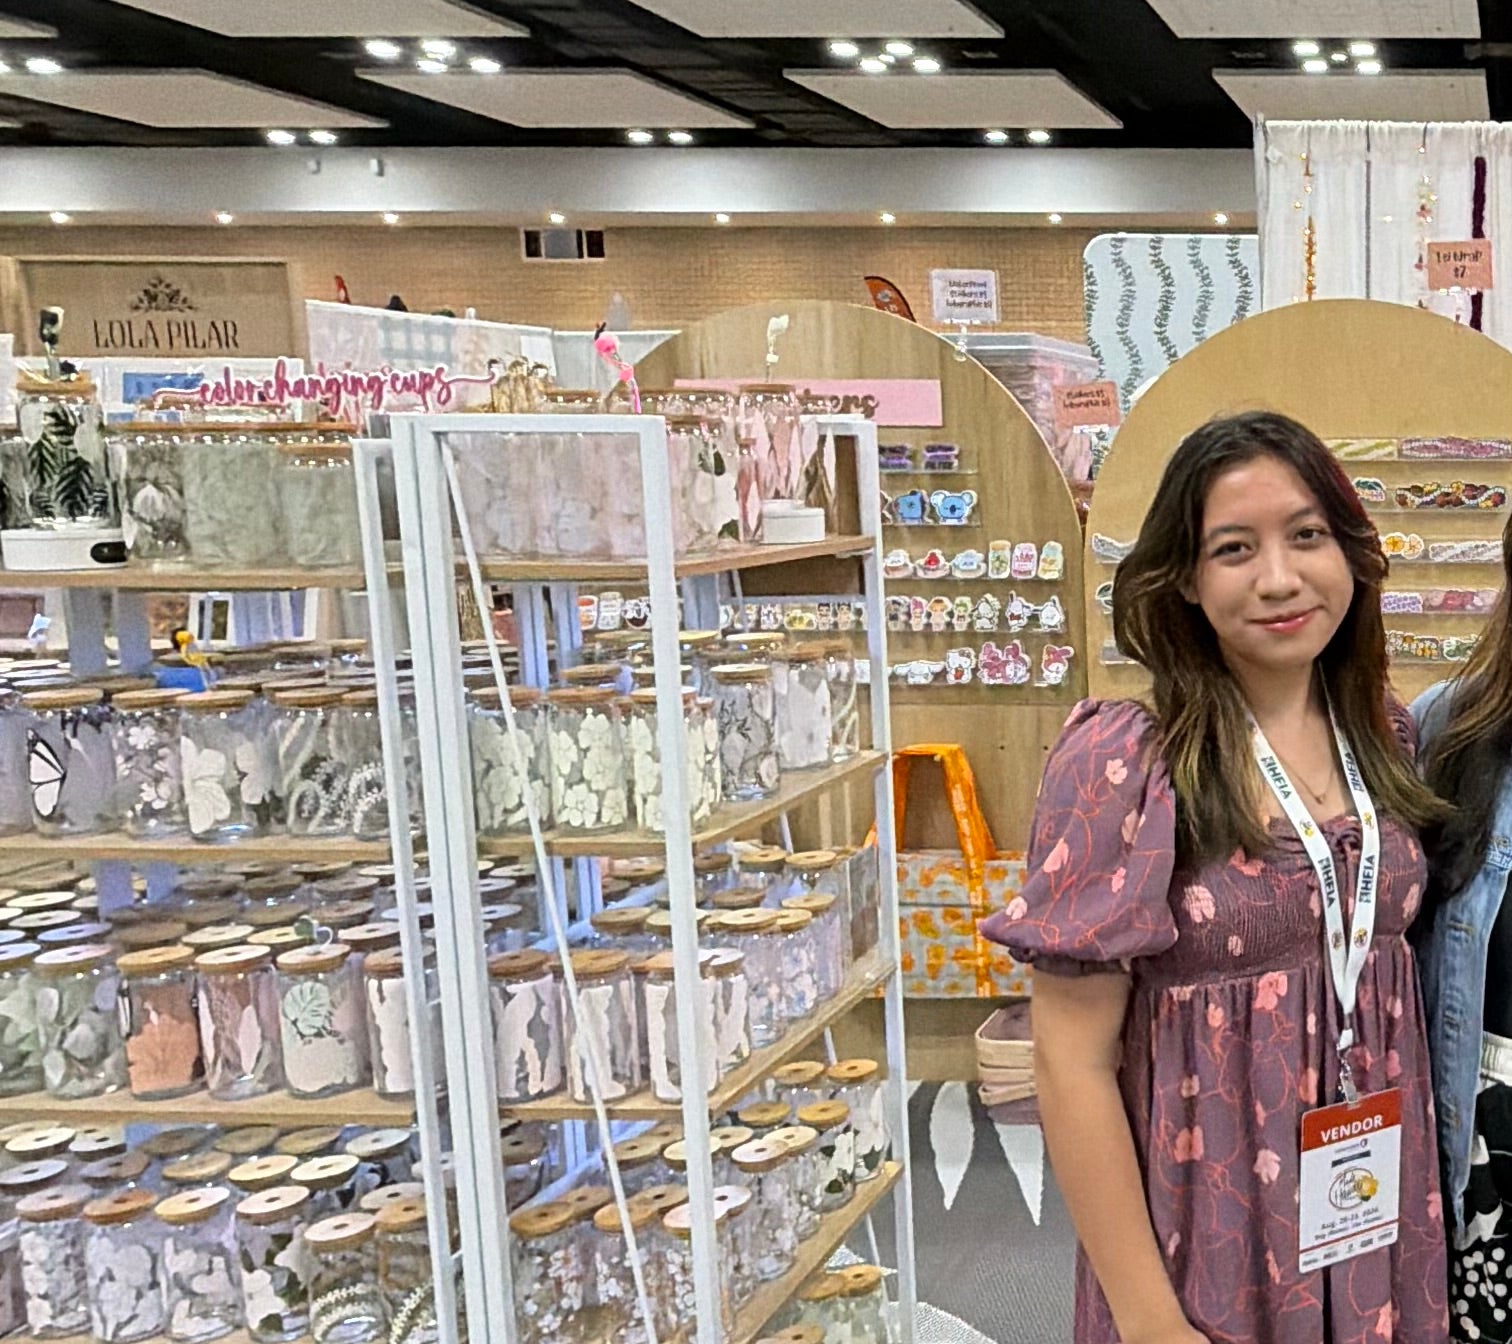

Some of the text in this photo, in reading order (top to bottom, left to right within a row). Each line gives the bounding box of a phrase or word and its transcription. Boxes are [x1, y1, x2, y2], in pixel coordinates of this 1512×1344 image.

[92, 318, 240, 350] LOLA PILAR
[183, 356, 466, 414] color changing cups
[1320, 1114, 1383, 1143] VENDOR
